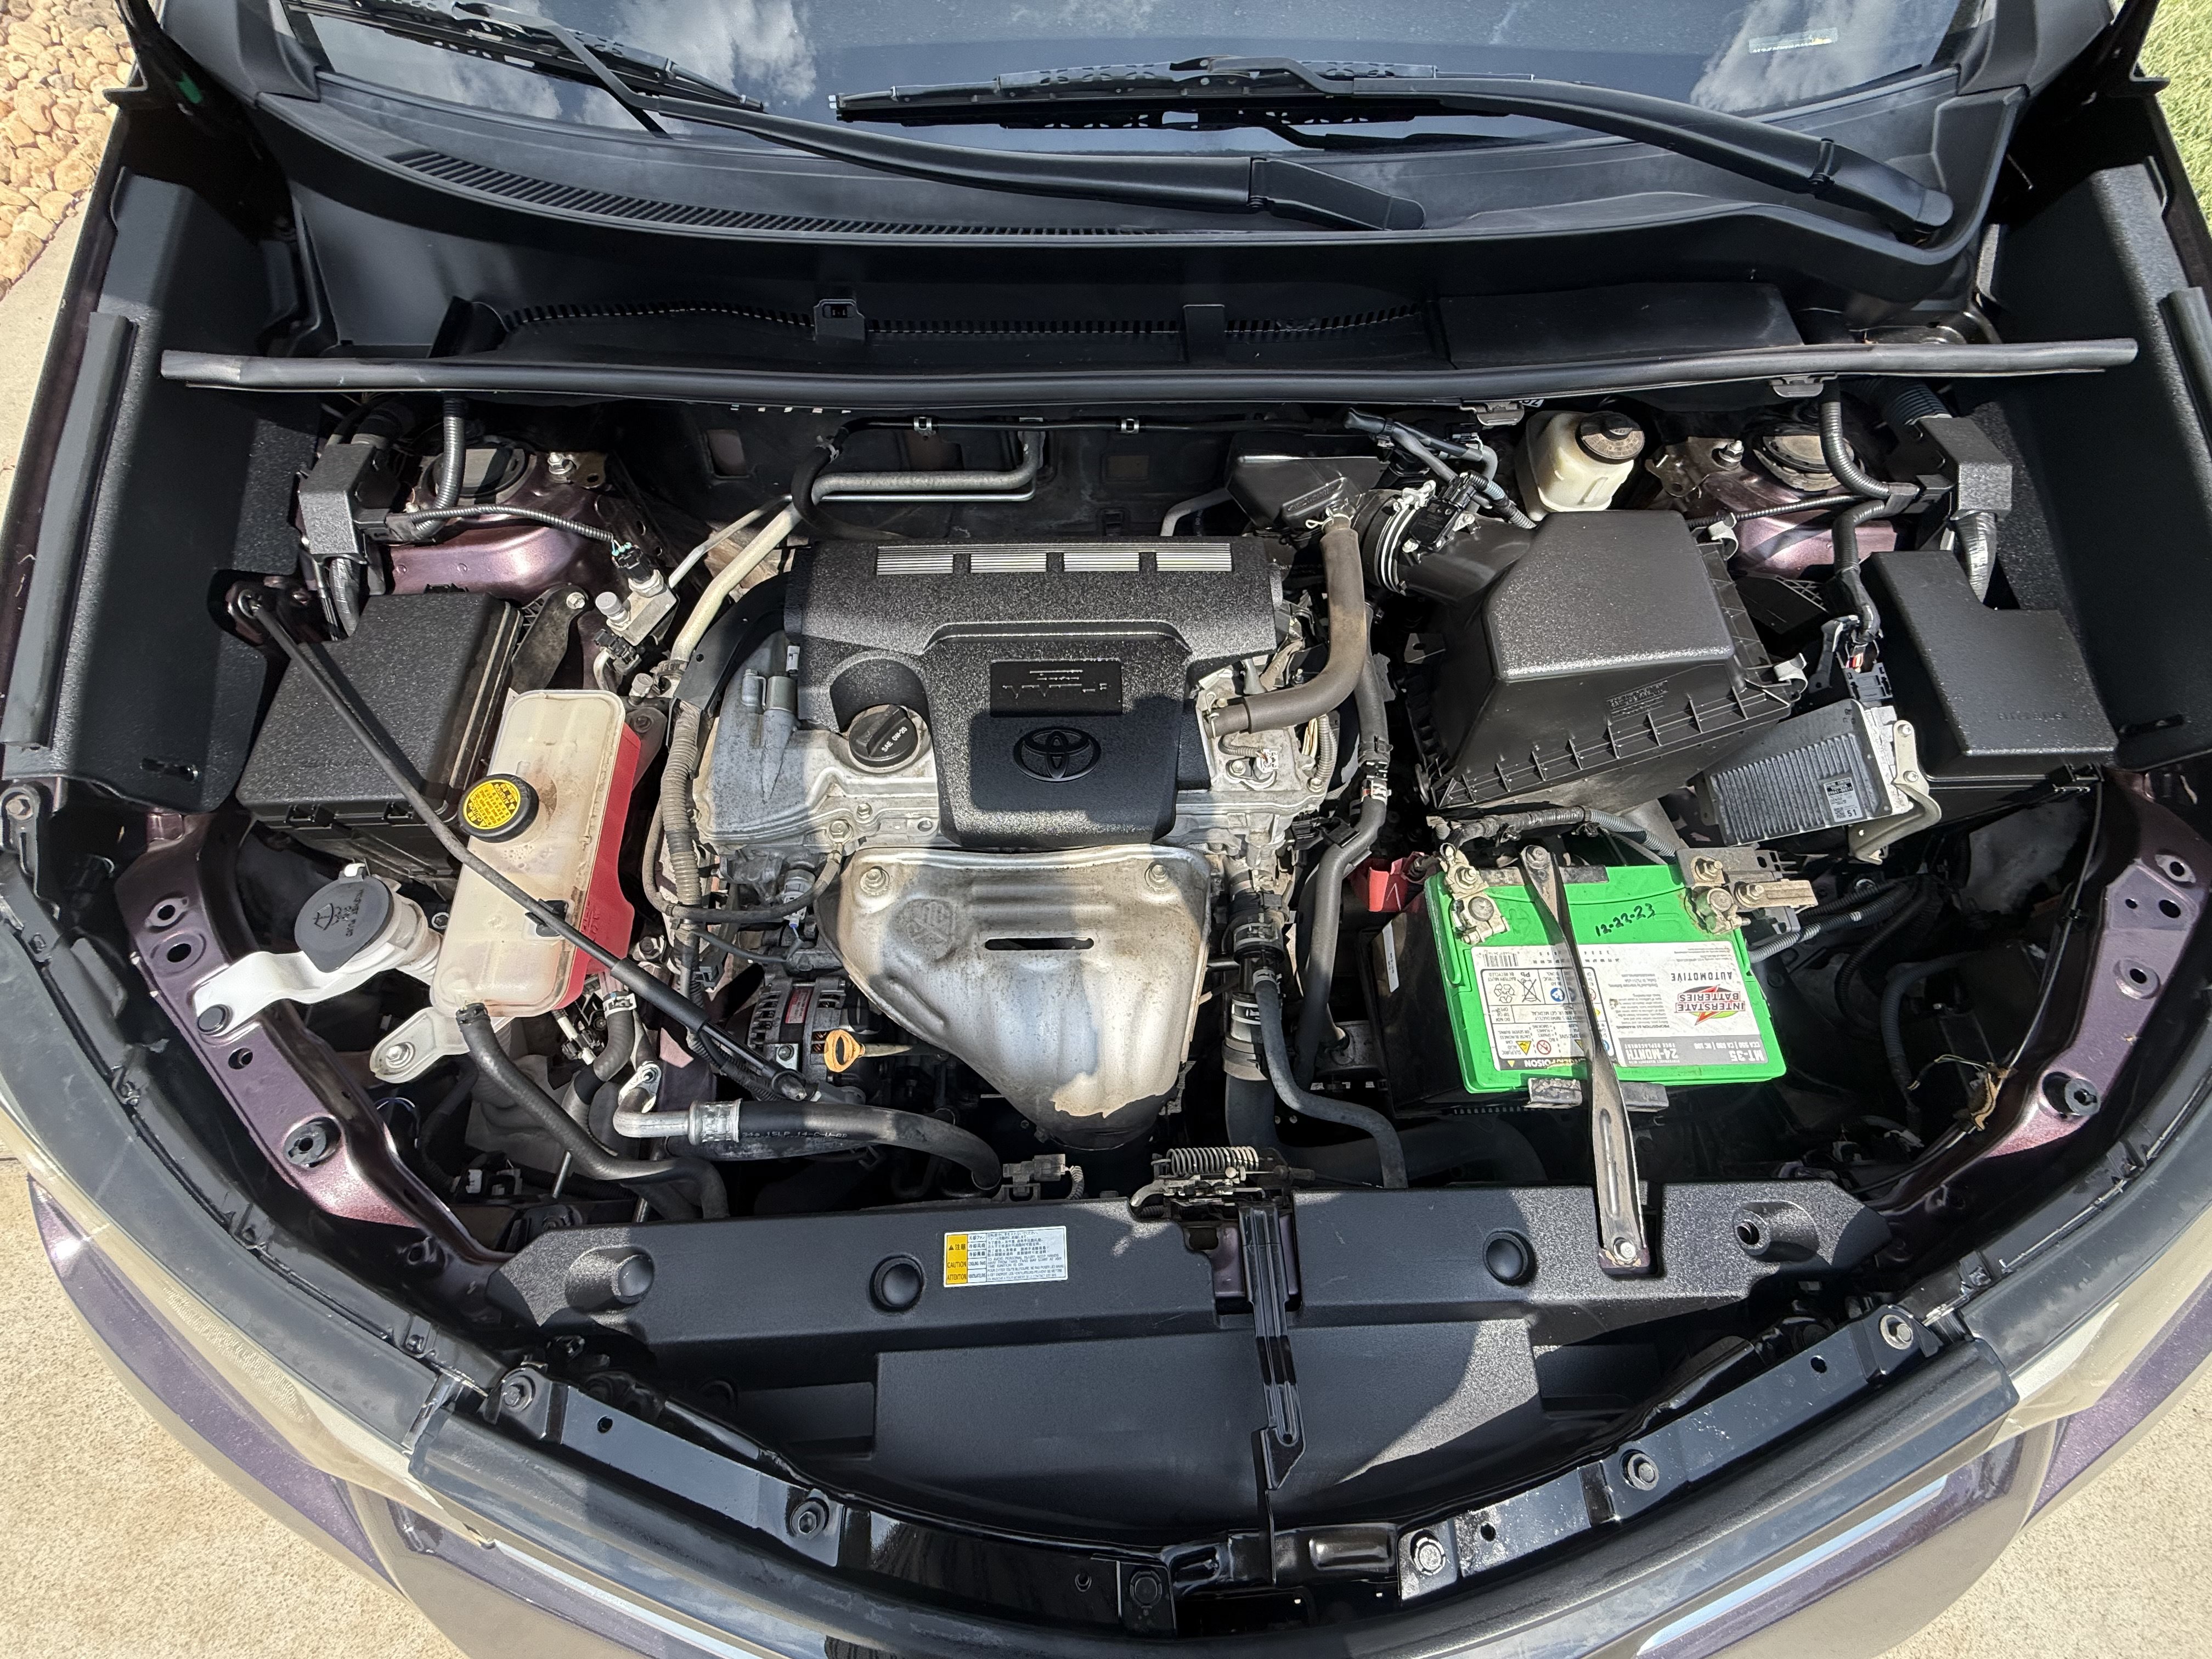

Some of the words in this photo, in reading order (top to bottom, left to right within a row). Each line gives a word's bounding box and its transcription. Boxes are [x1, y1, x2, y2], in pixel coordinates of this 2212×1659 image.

[881, 741, 893, 752] SAE
[892, 726, 908, 741] 0W-20
[469, 802, 483, 822] CAUTION
[1847, 809, 1857, 817] 51
[1671, 972, 1732, 981] AUTOMOTIVE
[1679, 993, 1739, 1002] BATTERIES
[1677, 1002, 1744, 1011] INTERSTATE
[1626, 1048, 1678, 1060] 24-MONTH
[1729, 1049, 1765, 1062] MT-35
